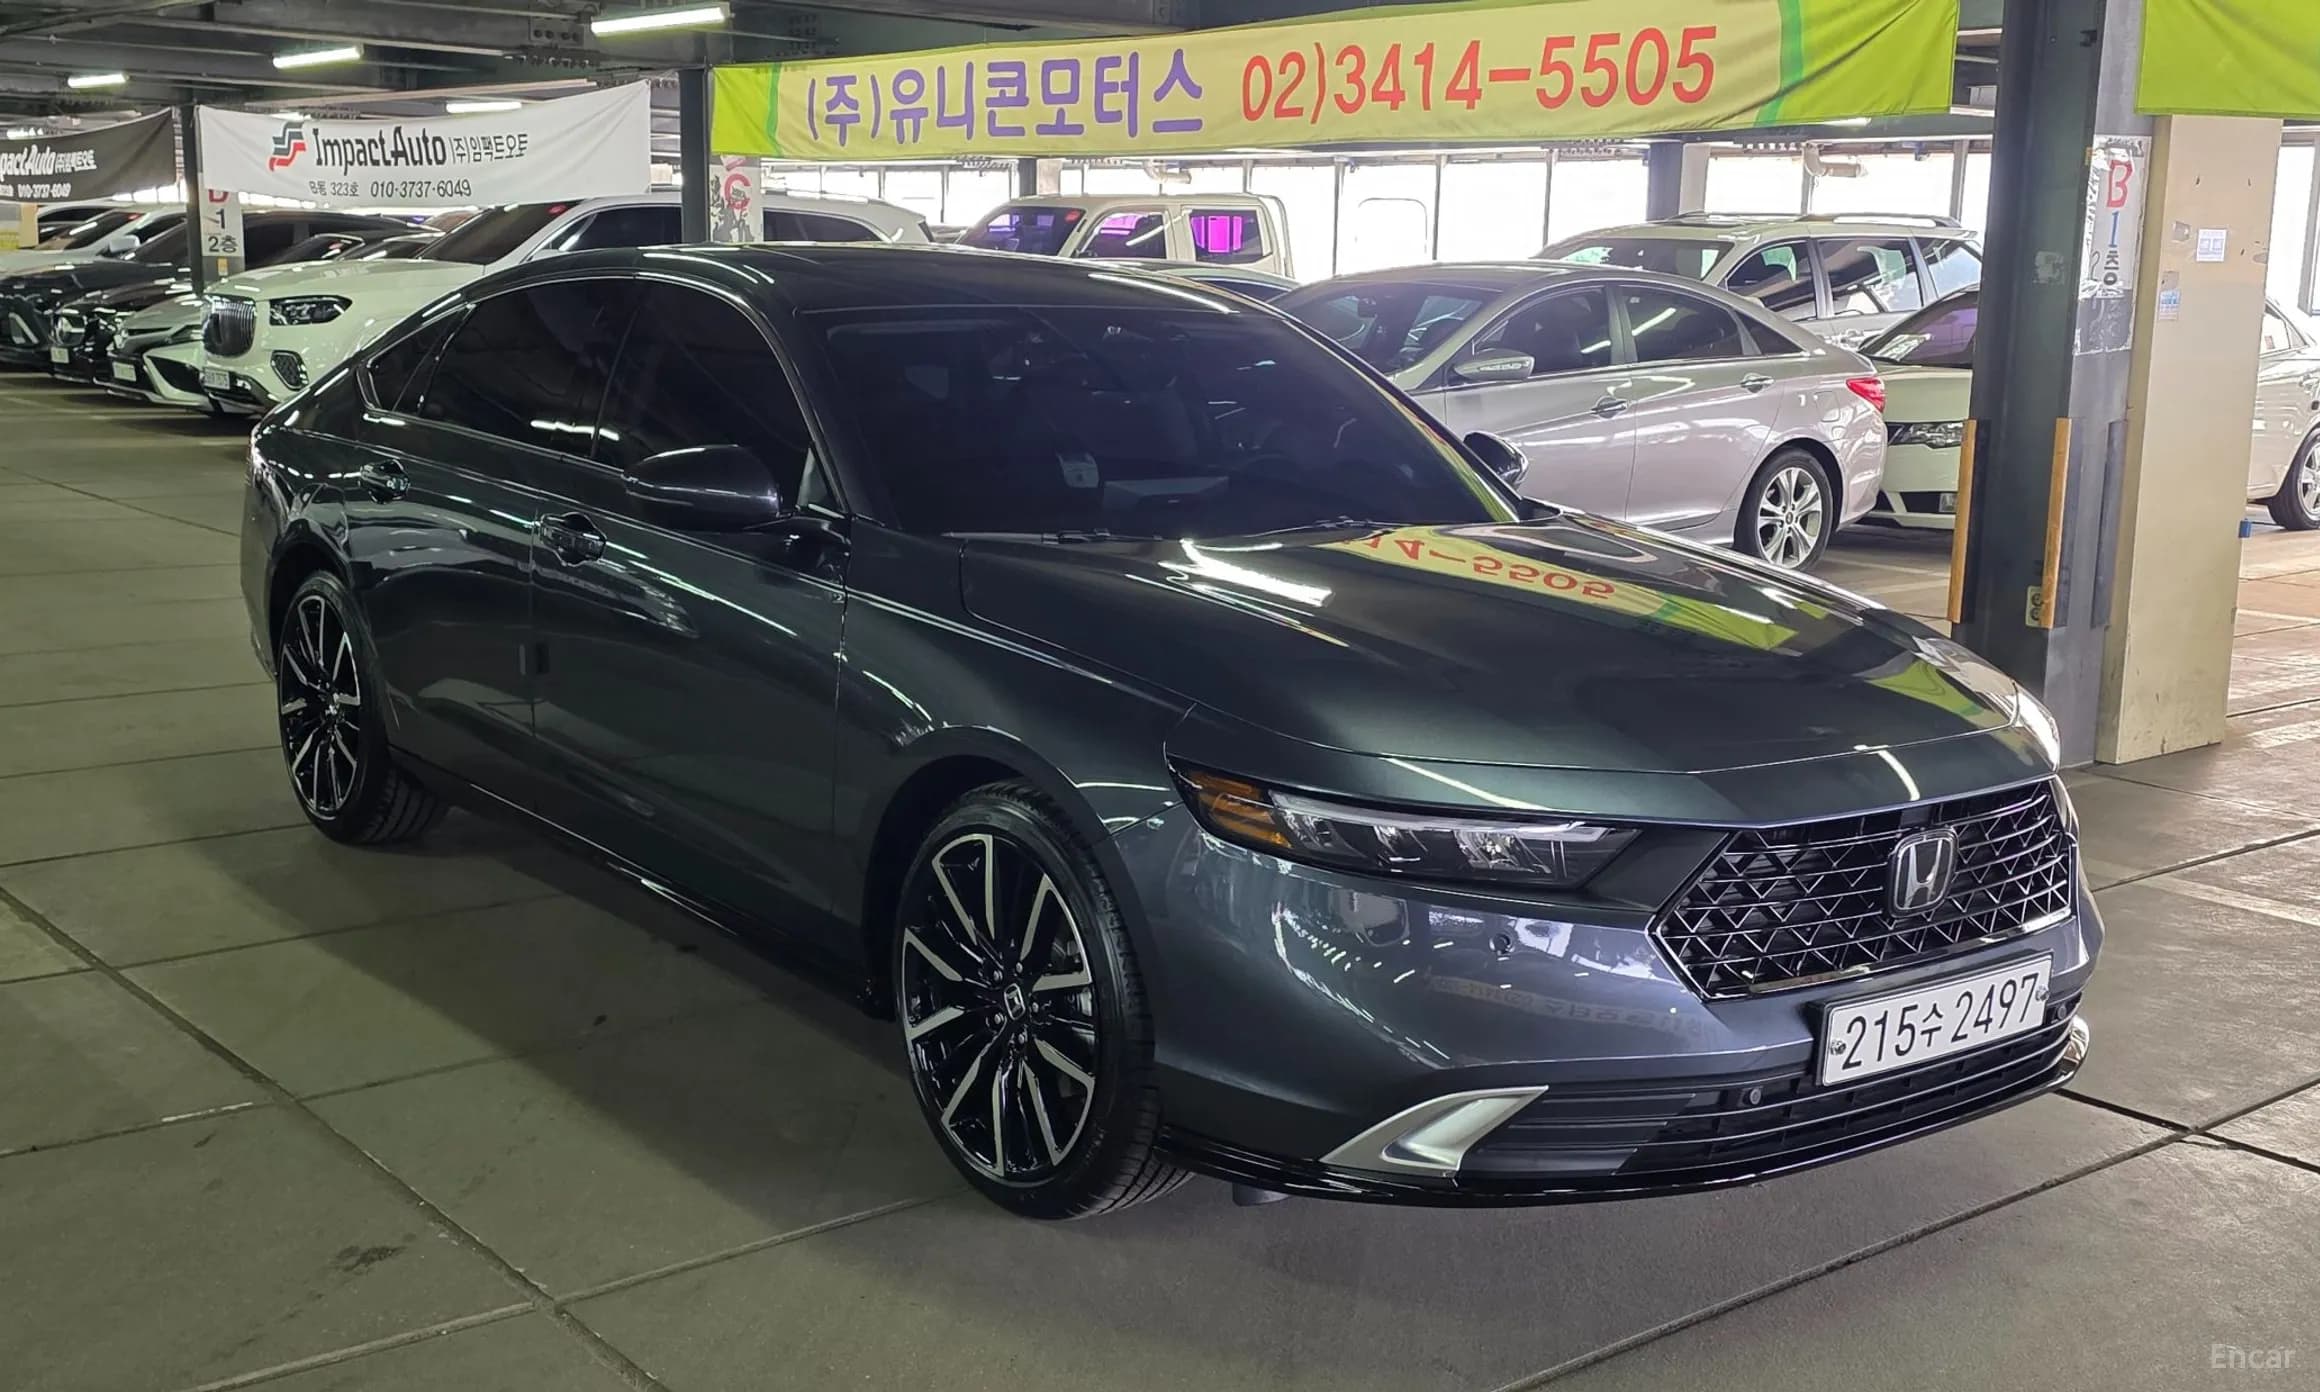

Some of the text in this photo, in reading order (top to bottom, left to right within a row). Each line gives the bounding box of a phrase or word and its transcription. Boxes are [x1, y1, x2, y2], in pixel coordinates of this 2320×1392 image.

[808, 25, 1718, 147] (주)유니콘모터스 02)3414-5505
[2106, 159, 2135, 208] B
[216, 208, 225, 229] 1
[2109, 211, 2120, 248] 1
[208, 234, 238, 253] 2층
[1841, 972, 2040, 1070] 215수 2497
